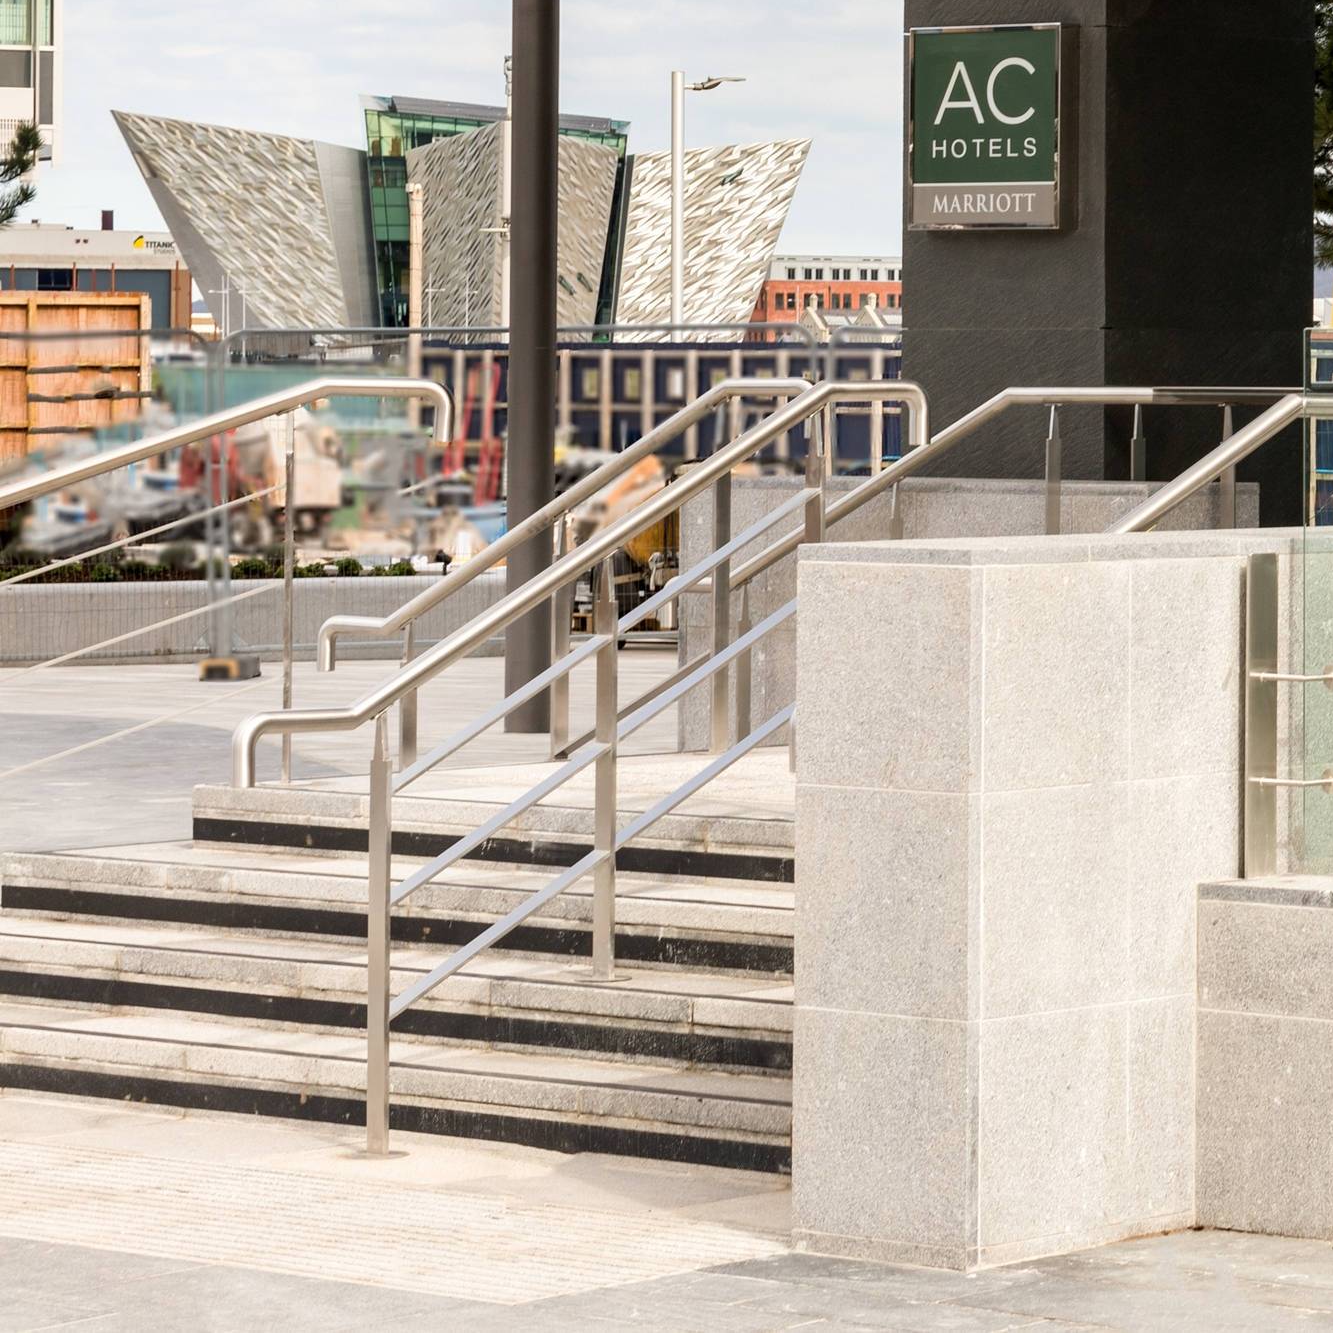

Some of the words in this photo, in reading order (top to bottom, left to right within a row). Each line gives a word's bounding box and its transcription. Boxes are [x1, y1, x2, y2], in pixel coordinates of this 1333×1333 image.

[933, 56, 1036, 126] AC
[932, 137, 1037, 159] HOTELS
[932, 192, 1036, 213] MARRIOTT
